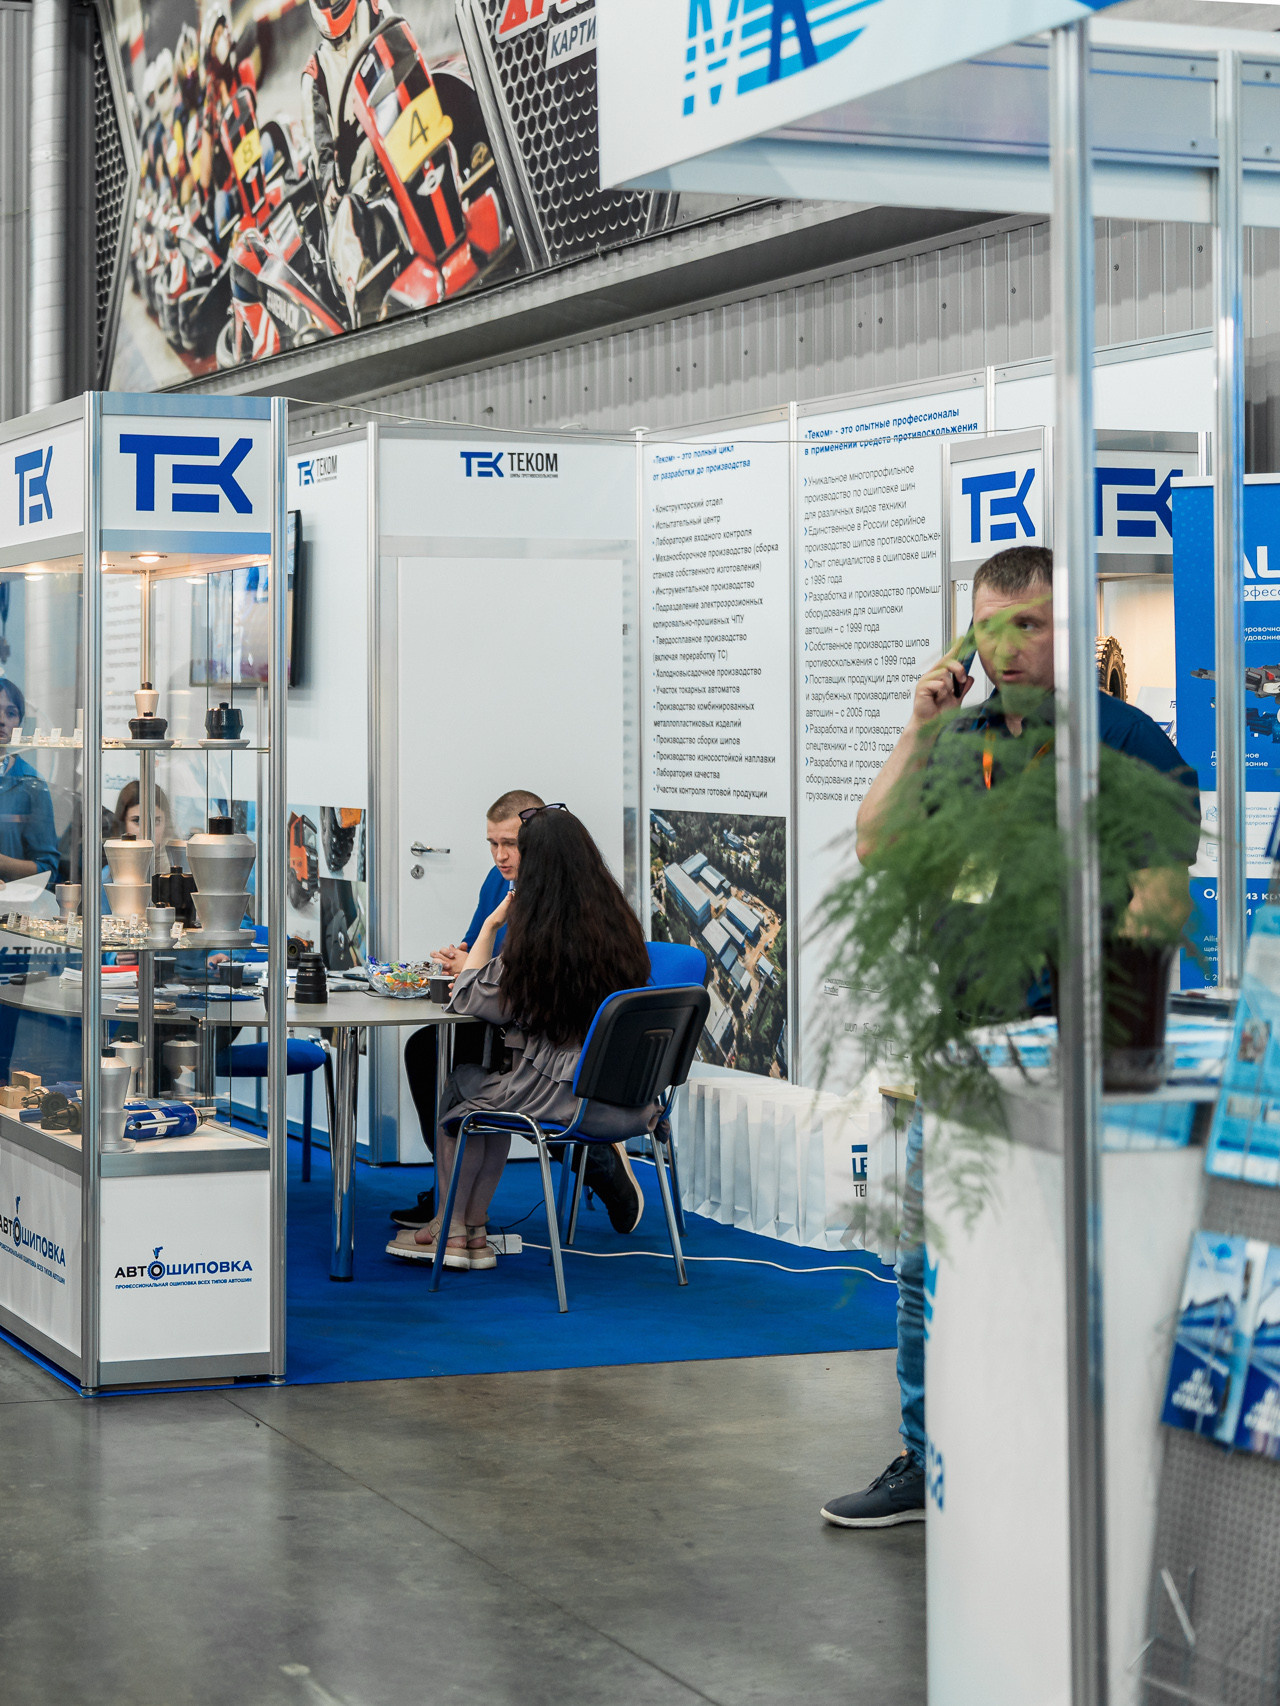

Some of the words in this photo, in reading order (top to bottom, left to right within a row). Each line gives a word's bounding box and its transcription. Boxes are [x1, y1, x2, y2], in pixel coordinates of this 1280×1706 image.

[410, 110, 428, 149] 4
[841, 425, 853, 434] это
[856, 420, 890, 433] опытные
[893, 408, 959, 427] профессионалы
[811, 441, 858, 454] применении
[860, 436, 891, 448] средств
[893, 422, 978, 443] противоскольжения
[694, 446, 716, 458] полный
[719, 445, 734, 454] цикл
[508, 453, 558, 471] ТЕКОМ
[661, 468, 694, 481] разработки
[697, 466, 703, 475] до
[706, 459, 750, 473] производства
[808, 471, 847, 486] Уникальное
[849, 464, 914, 480] многопрофильное
[804, 488, 851, 503] производство
[863, 484, 899, 497] ошиповке
[901, 482, 916, 491] шин
[656, 499, 703, 513] Конструкторский
[706, 498, 723, 506] отдел
[804, 511, 816, 520] для
[818, 506, 853, 520] различных
[856, 503, 876, 514] видов
[879, 500, 906, 510] техники
[656, 516, 701, 529] Испытательный
[703, 515, 720, 525] центр
[809, 522, 855, 536] Единственное
[863, 519, 888, 529] России
[891, 515, 925, 528] серийное
[656, 536, 692, 546] Лаборатория
[694, 532, 721, 542] входного
[723, 528, 752, 539] контроля
[805, 539, 850, 553] производство
[853, 537, 875, 549] шипов
[656, 550, 706, 562] Механосборочное
[708, 546, 751, 557] производство
[754, 543, 778, 555] (сборка
[809, 559, 826, 569] Опыт
[828, 555, 875, 568] специалистов
[883, 551, 919, 563] ошиповке
[921, 550, 936, 559] шин
[653, 570, 674, 579] станков
[676, 567, 715, 577] собственного
[717, 561, 761, 573] изготовления)
[810, 575, 826, 584] 1995
[828, 574, 842, 584] года
[656, 584, 709, 596] Инструментальное
[711, 581, 754, 591] производство
[809, 590, 847, 602] Разработка
[855, 586, 904, 600] производство
[656, 603, 699, 612] Подразделение
[701, 598, 763, 609] электроэрозионных
[805, 607, 851, 620] оборудования
[853, 607, 865, 616] для
[867, 604, 903, 615] ошиповки
[731, 614, 744, 624] ЧПУ
[805, 625, 832, 635] автошин
[846, 623, 862, 632] 1999
[864, 623, 879, 632] года
[656, 635, 701, 646] Твердосплавное
[704, 633, 747, 643] производство
[809, 641, 852, 651] Собственное
[854, 639, 903, 651] производство
[905, 638, 930, 648] шипов
[653, 653, 678, 663] (включая
[680, 651, 716, 661] переработку
[718, 650, 728, 660] ТС)
[805, 657, 872, 668] противоскольжения
[881, 656, 897, 665] 1999
[899, 656, 916, 666] года
[656, 669, 715, 677] Холодновысадочное
[717, 668, 761, 676] производство
[809, 675, 846, 684] Поставщик
[848, 674, 884, 685] продукции
[886, 674, 899, 683] для
[656, 686, 677, 694] Участок
[679, 686, 706, 695] токарных
[812, 690, 852, 702] зарубежных
[854, 689, 911, 701] производителей
[656, 702, 695, 711] Производство
[697, 701, 754, 711] комбинированных
[806, 709, 833, 717] автошин
[847, 708, 863, 717] 2005
[865, 709, 880, 718] года
[654, 720, 713, 728] металлопластиковых
[716, 719, 741, 728] изделий
[809, 725, 847, 735] Разработка
[656, 735, 695, 744] Производство
[697, 735, 718, 746] сборки
[720, 737, 740, 745] шипов
[806, 743, 846, 751] спецтехники
[860, 741, 876, 751] 2013
[878, 743, 893, 752] года
[656, 751, 695, 761] Производство
[697, 753, 742, 762] износостойкой
[809, 757, 847, 768] Разработка
[656, 768, 692, 778] Лаборатория
[694, 771, 720, 779] качества
[806, 775, 852, 785] оборудования
[854, 776, 867, 786] для
[656, 785, 677, 794] Участок
[679, 786, 705, 797] контроля
[707, 788, 731, 797] готовой
[733, 789, 767, 799] продукции
[806, 791, 842, 802] грузовиков
[115, 1260, 252, 1280] АВТОШИПОВКА
